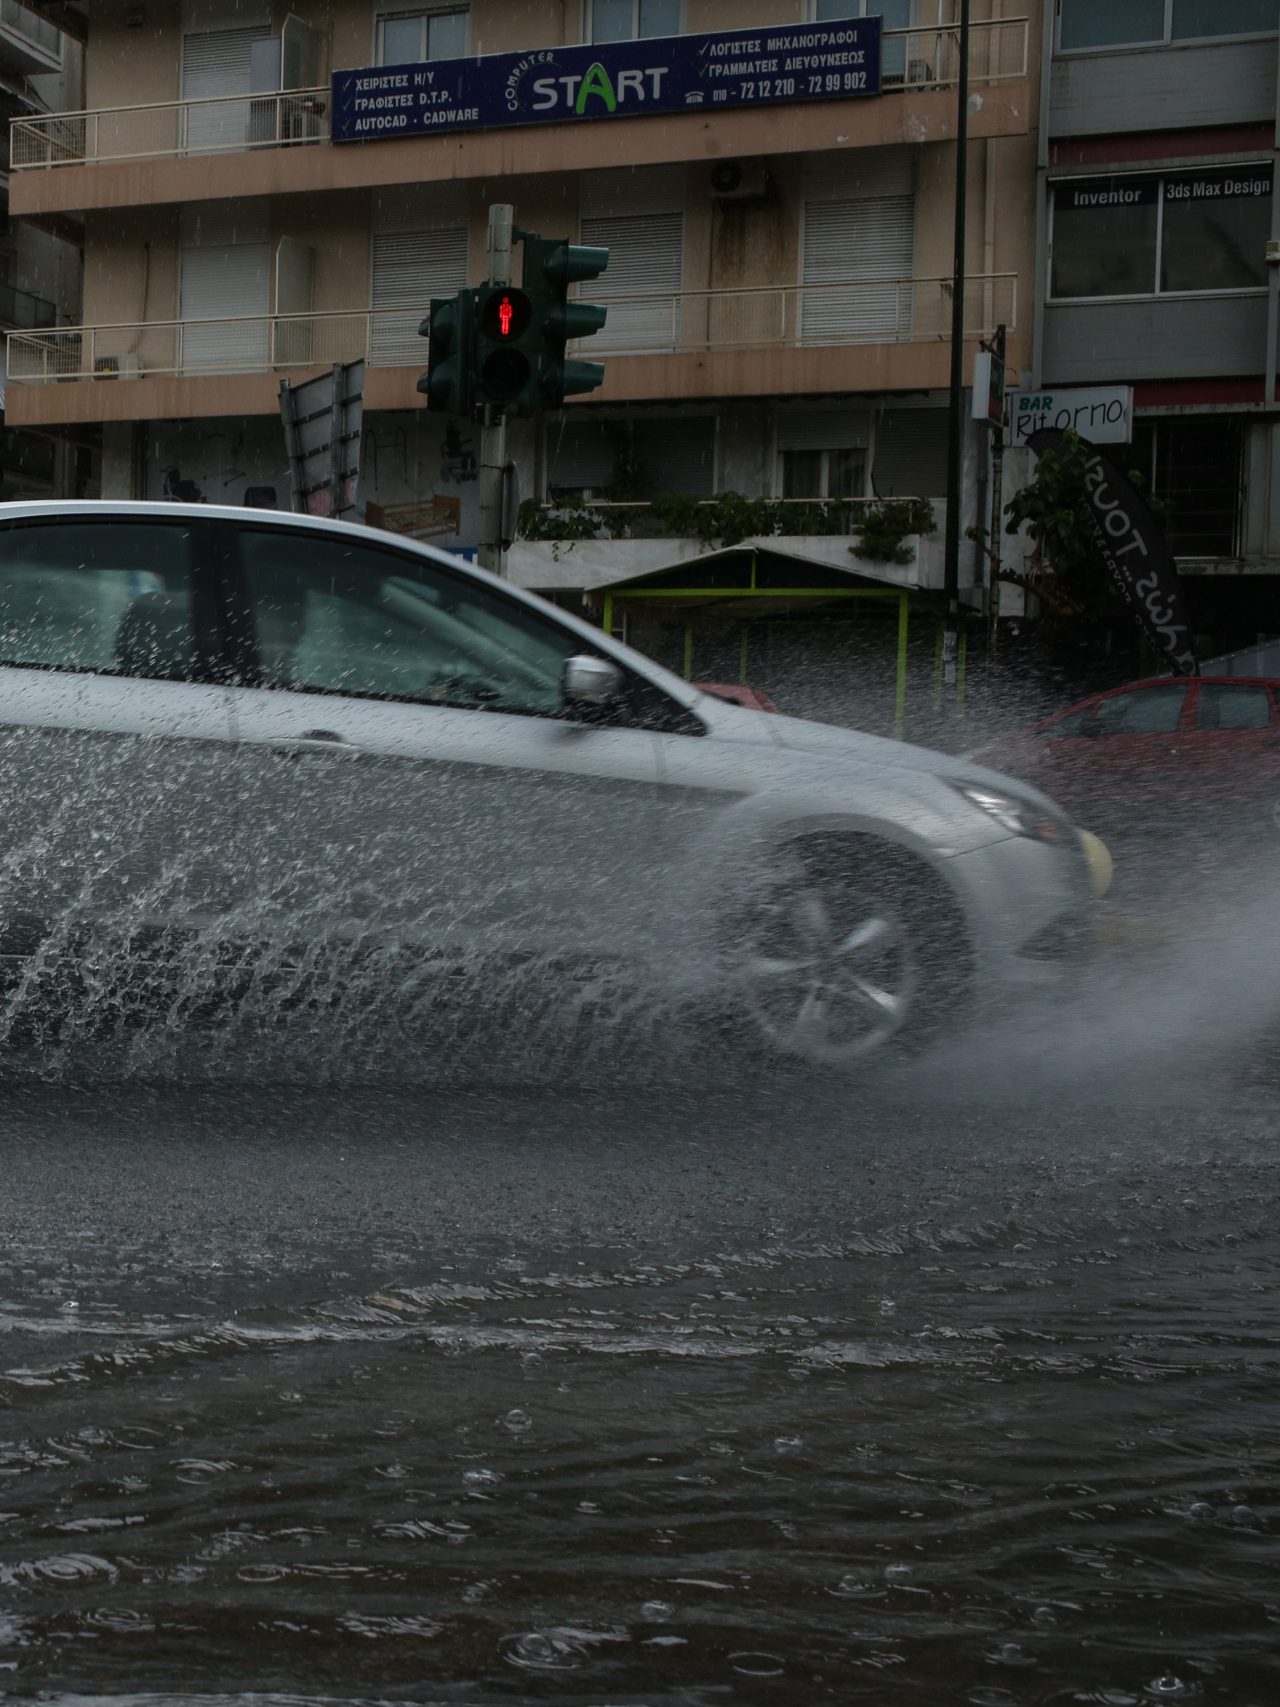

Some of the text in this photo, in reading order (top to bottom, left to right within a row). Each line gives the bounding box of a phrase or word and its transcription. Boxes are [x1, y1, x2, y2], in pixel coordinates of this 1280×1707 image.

[710, 30, 857, 57] ΛΟΓΙΣΤΕΣ ΜΗΧΑΝΟΓΡΑΦΟΙ
[709, 50, 865, 78] ΓΡΑΜΜΑΤΕΙΣ ΔΙΕΥΘΥΝΣΕΩΣ
[355, 74, 409, 91] ΧΕΙΡΙΣΤΕΣ
[505, 51, 555, 111] COMPUTER
[532, 62, 669, 116] START
[740, 82, 755, 99] 72
[758, 80, 771, 97] 12
[775, 78, 795, 96] 210
[808, 75, 822, 93] 72
[826, 74, 841, 91] 99
[844, 71, 867, 89] 902
[354, 91, 453, 111] ΓΡΑΦΙΣΤΕΣ D.T.P.
[355, 108, 480, 132] AUTOCAD CADWARE
[1073, 188, 1142, 206] Inventor
[1166, 178, 1271, 199] 3ds Max Design
[1019, 397, 1053, 411] BAR
